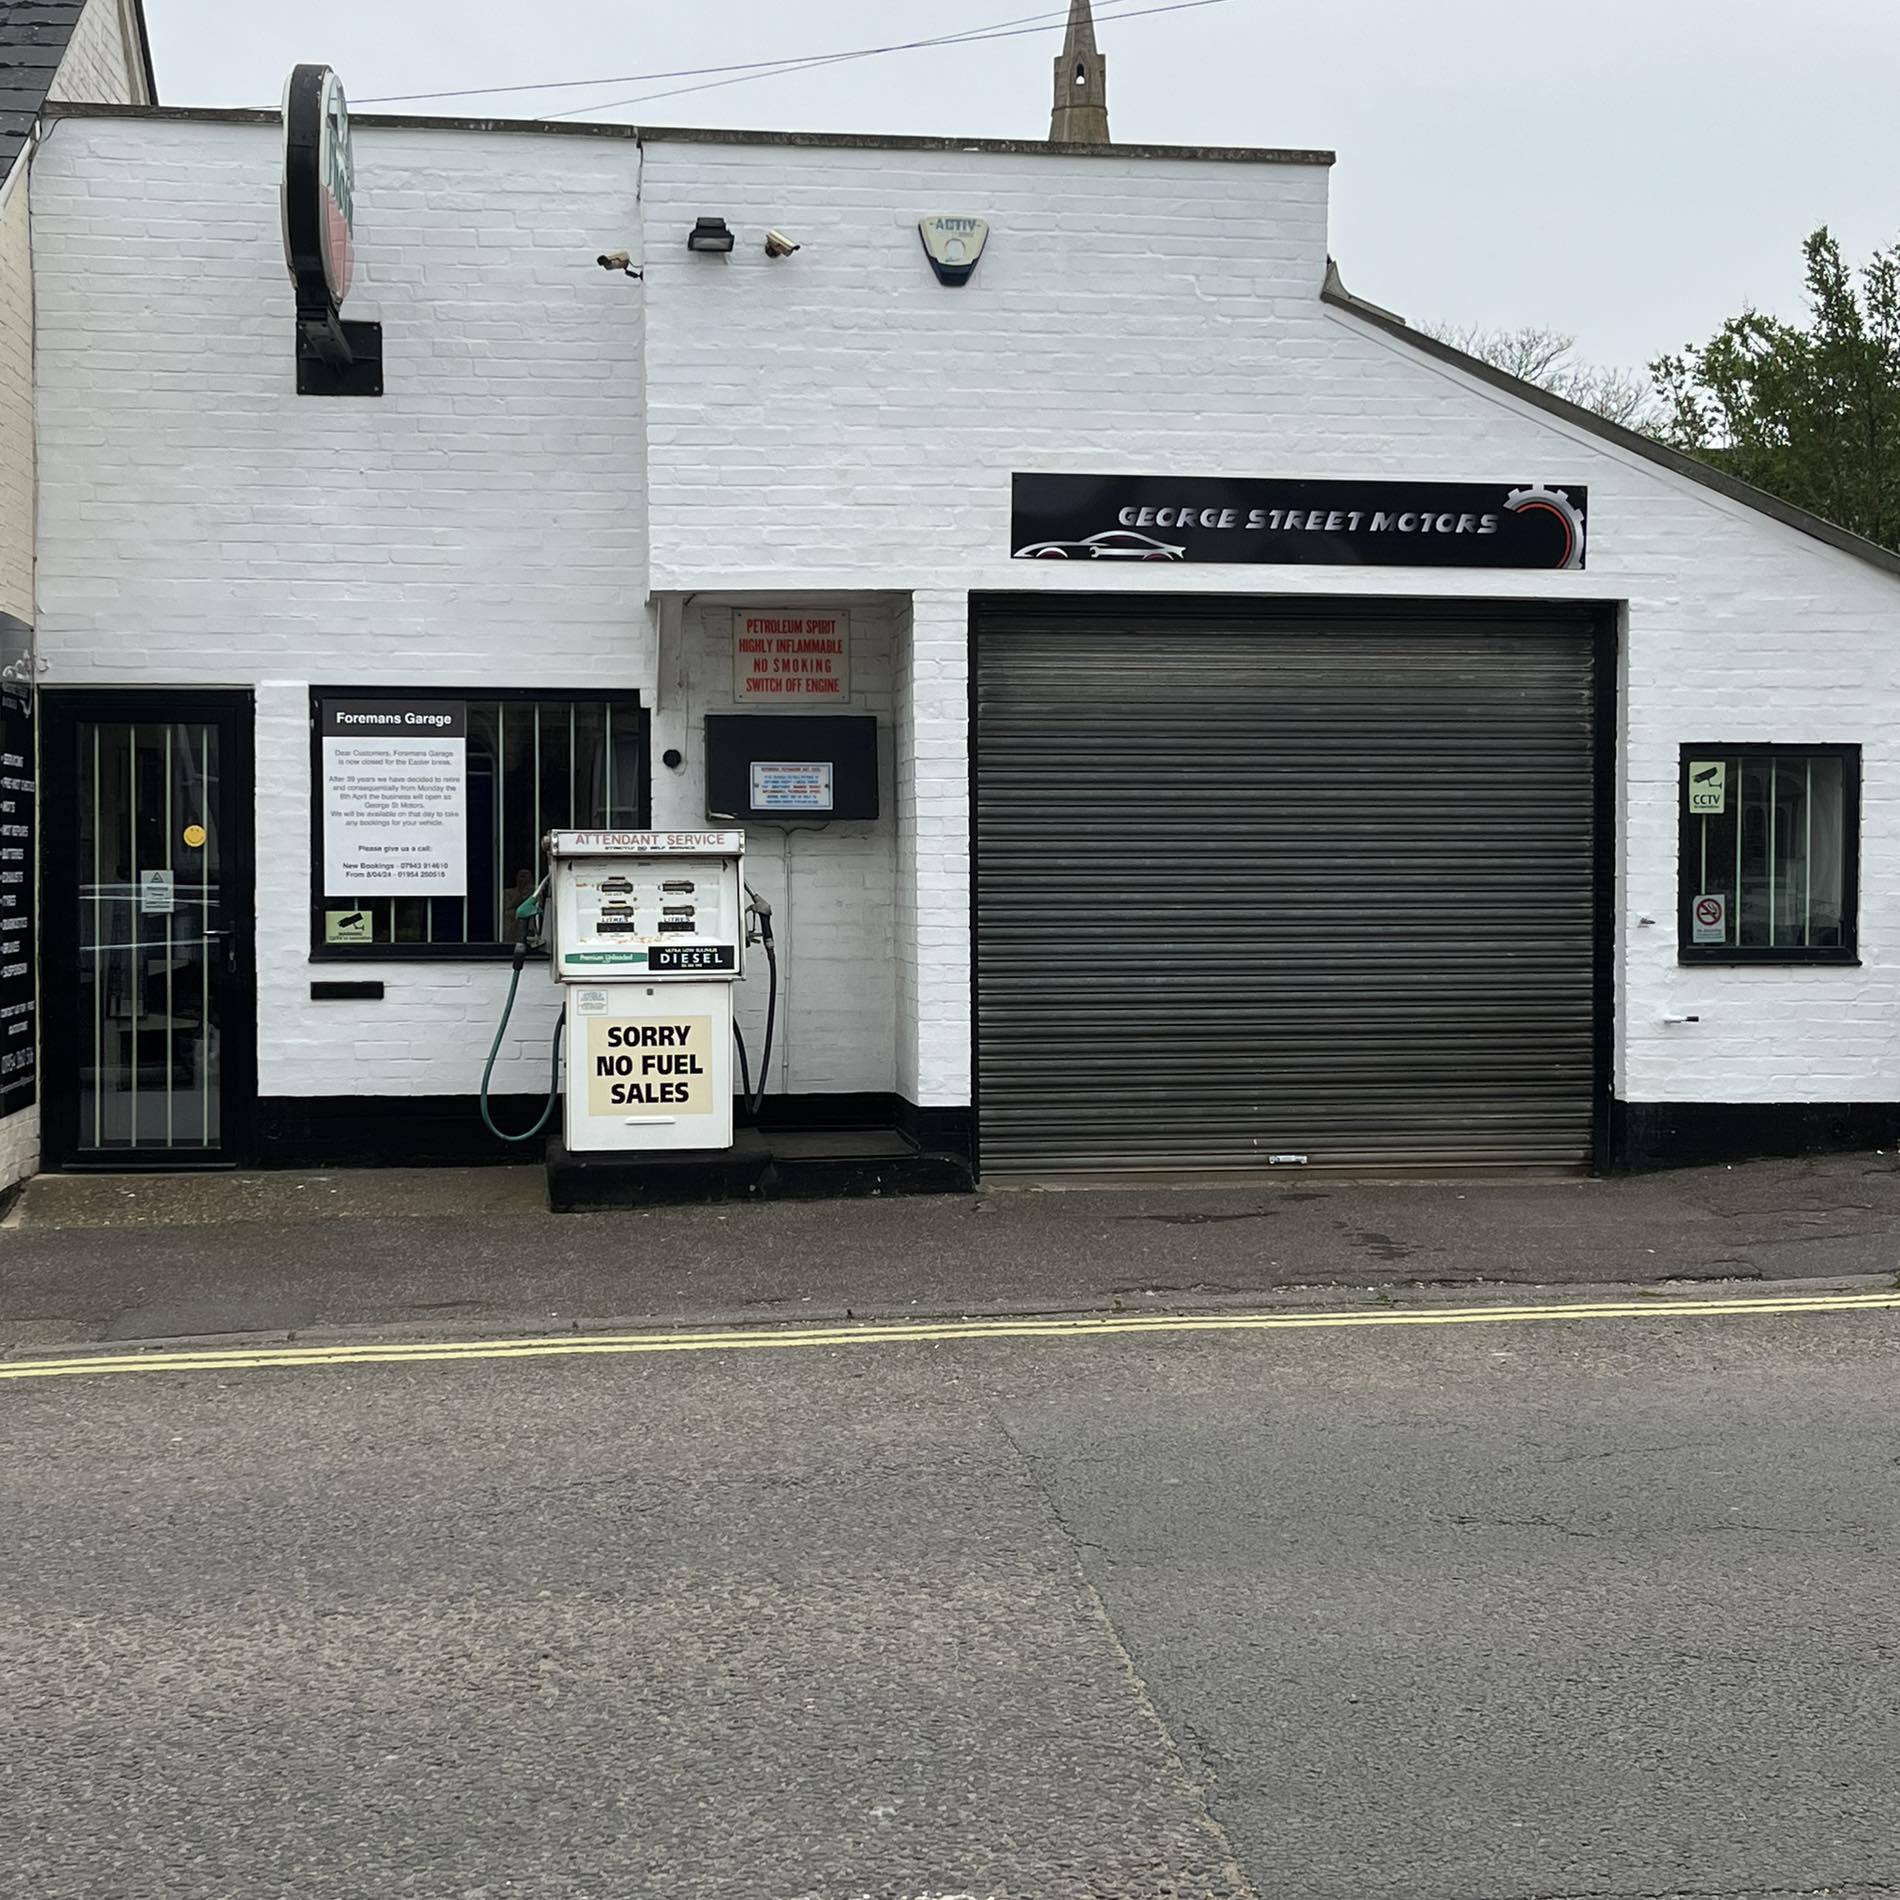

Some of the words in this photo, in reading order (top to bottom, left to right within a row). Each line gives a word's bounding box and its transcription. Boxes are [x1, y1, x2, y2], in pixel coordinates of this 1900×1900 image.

[936, 218, 976, 231] ACTIV
[1118, 505, 1236, 529] GEORGE
[1246, 509, 1365, 533] STREET
[1370, 511, 1499, 536] MOTORS
[746, 619, 803, 635] PETROLEUM
[806, 620, 836, 635] SPIRIT
[739, 639, 772, 653] HIGHLY
[776, 639, 844, 654] INFLAMMABLE
[754, 658, 768, 673] NO
[773, 658, 832, 673] SMOKING
[746, 678, 782, 693] SWITCH
[786, 678, 802, 693] OFF
[806, 678, 840, 693] ENGINE
[336, 712, 402, 725] Foremans
[404, 712, 452, 727] Garage
[429, 750, 454, 758] Garage
[357, 776, 375, 784] years
[364, 802, 389, 810] George
[1694, 794, 1720, 804] CCTV
[576, 834, 659, 845] ATTENDANT
[667, 834, 725, 845] SERVICE
[660, 953, 723, 964] DIESEL
[608, 1026, 691, 1047] SORRY
[596, 1056, 633, 1076] NO
[642, 1054, 704, 1075] FUEL
[611, 1082, 689, 1104] SALES
